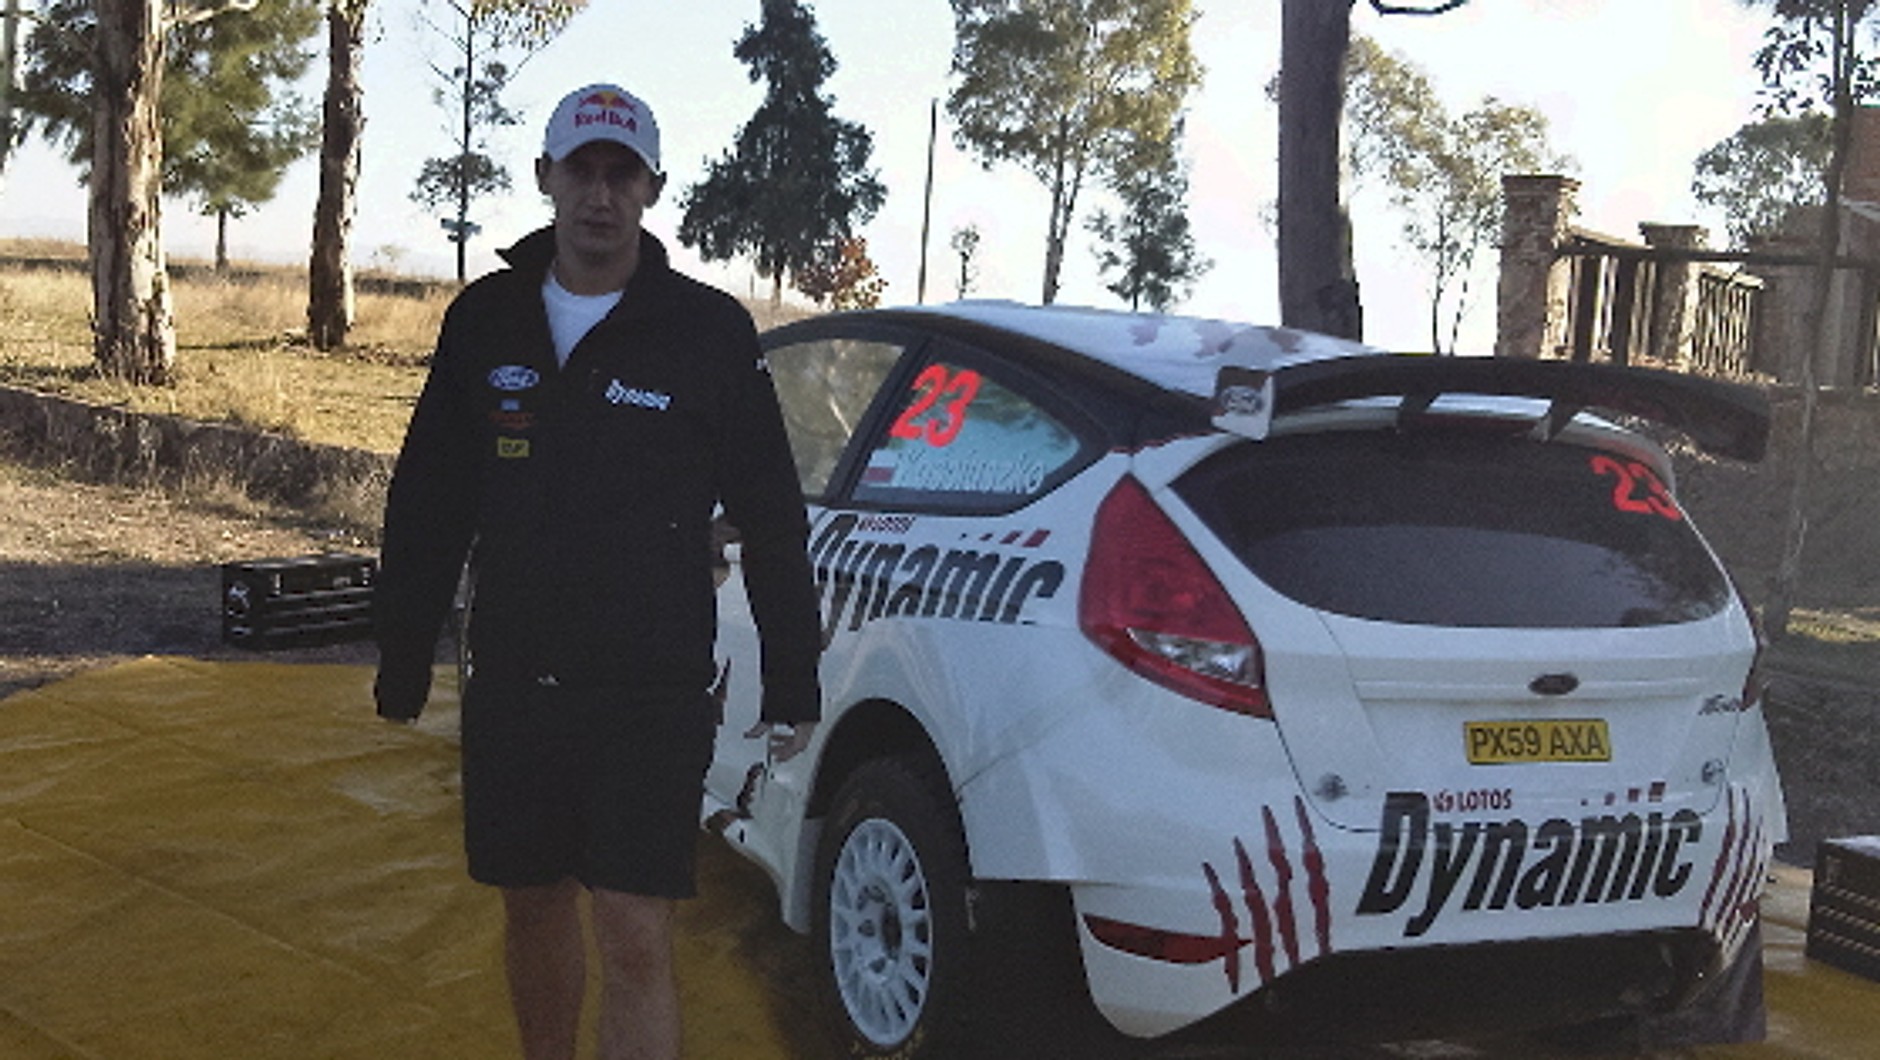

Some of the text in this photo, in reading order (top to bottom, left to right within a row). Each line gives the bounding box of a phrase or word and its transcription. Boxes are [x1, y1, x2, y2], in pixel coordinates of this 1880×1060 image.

[888, 363, 981, 448] 23
[1588, 455, 1682, 520] 23
[1470, 724, 1605, 757] PX59 AXA
[1457, 788, 1512, 812] LOTOS
[1355, 782, 1702, 937] Dynamic
